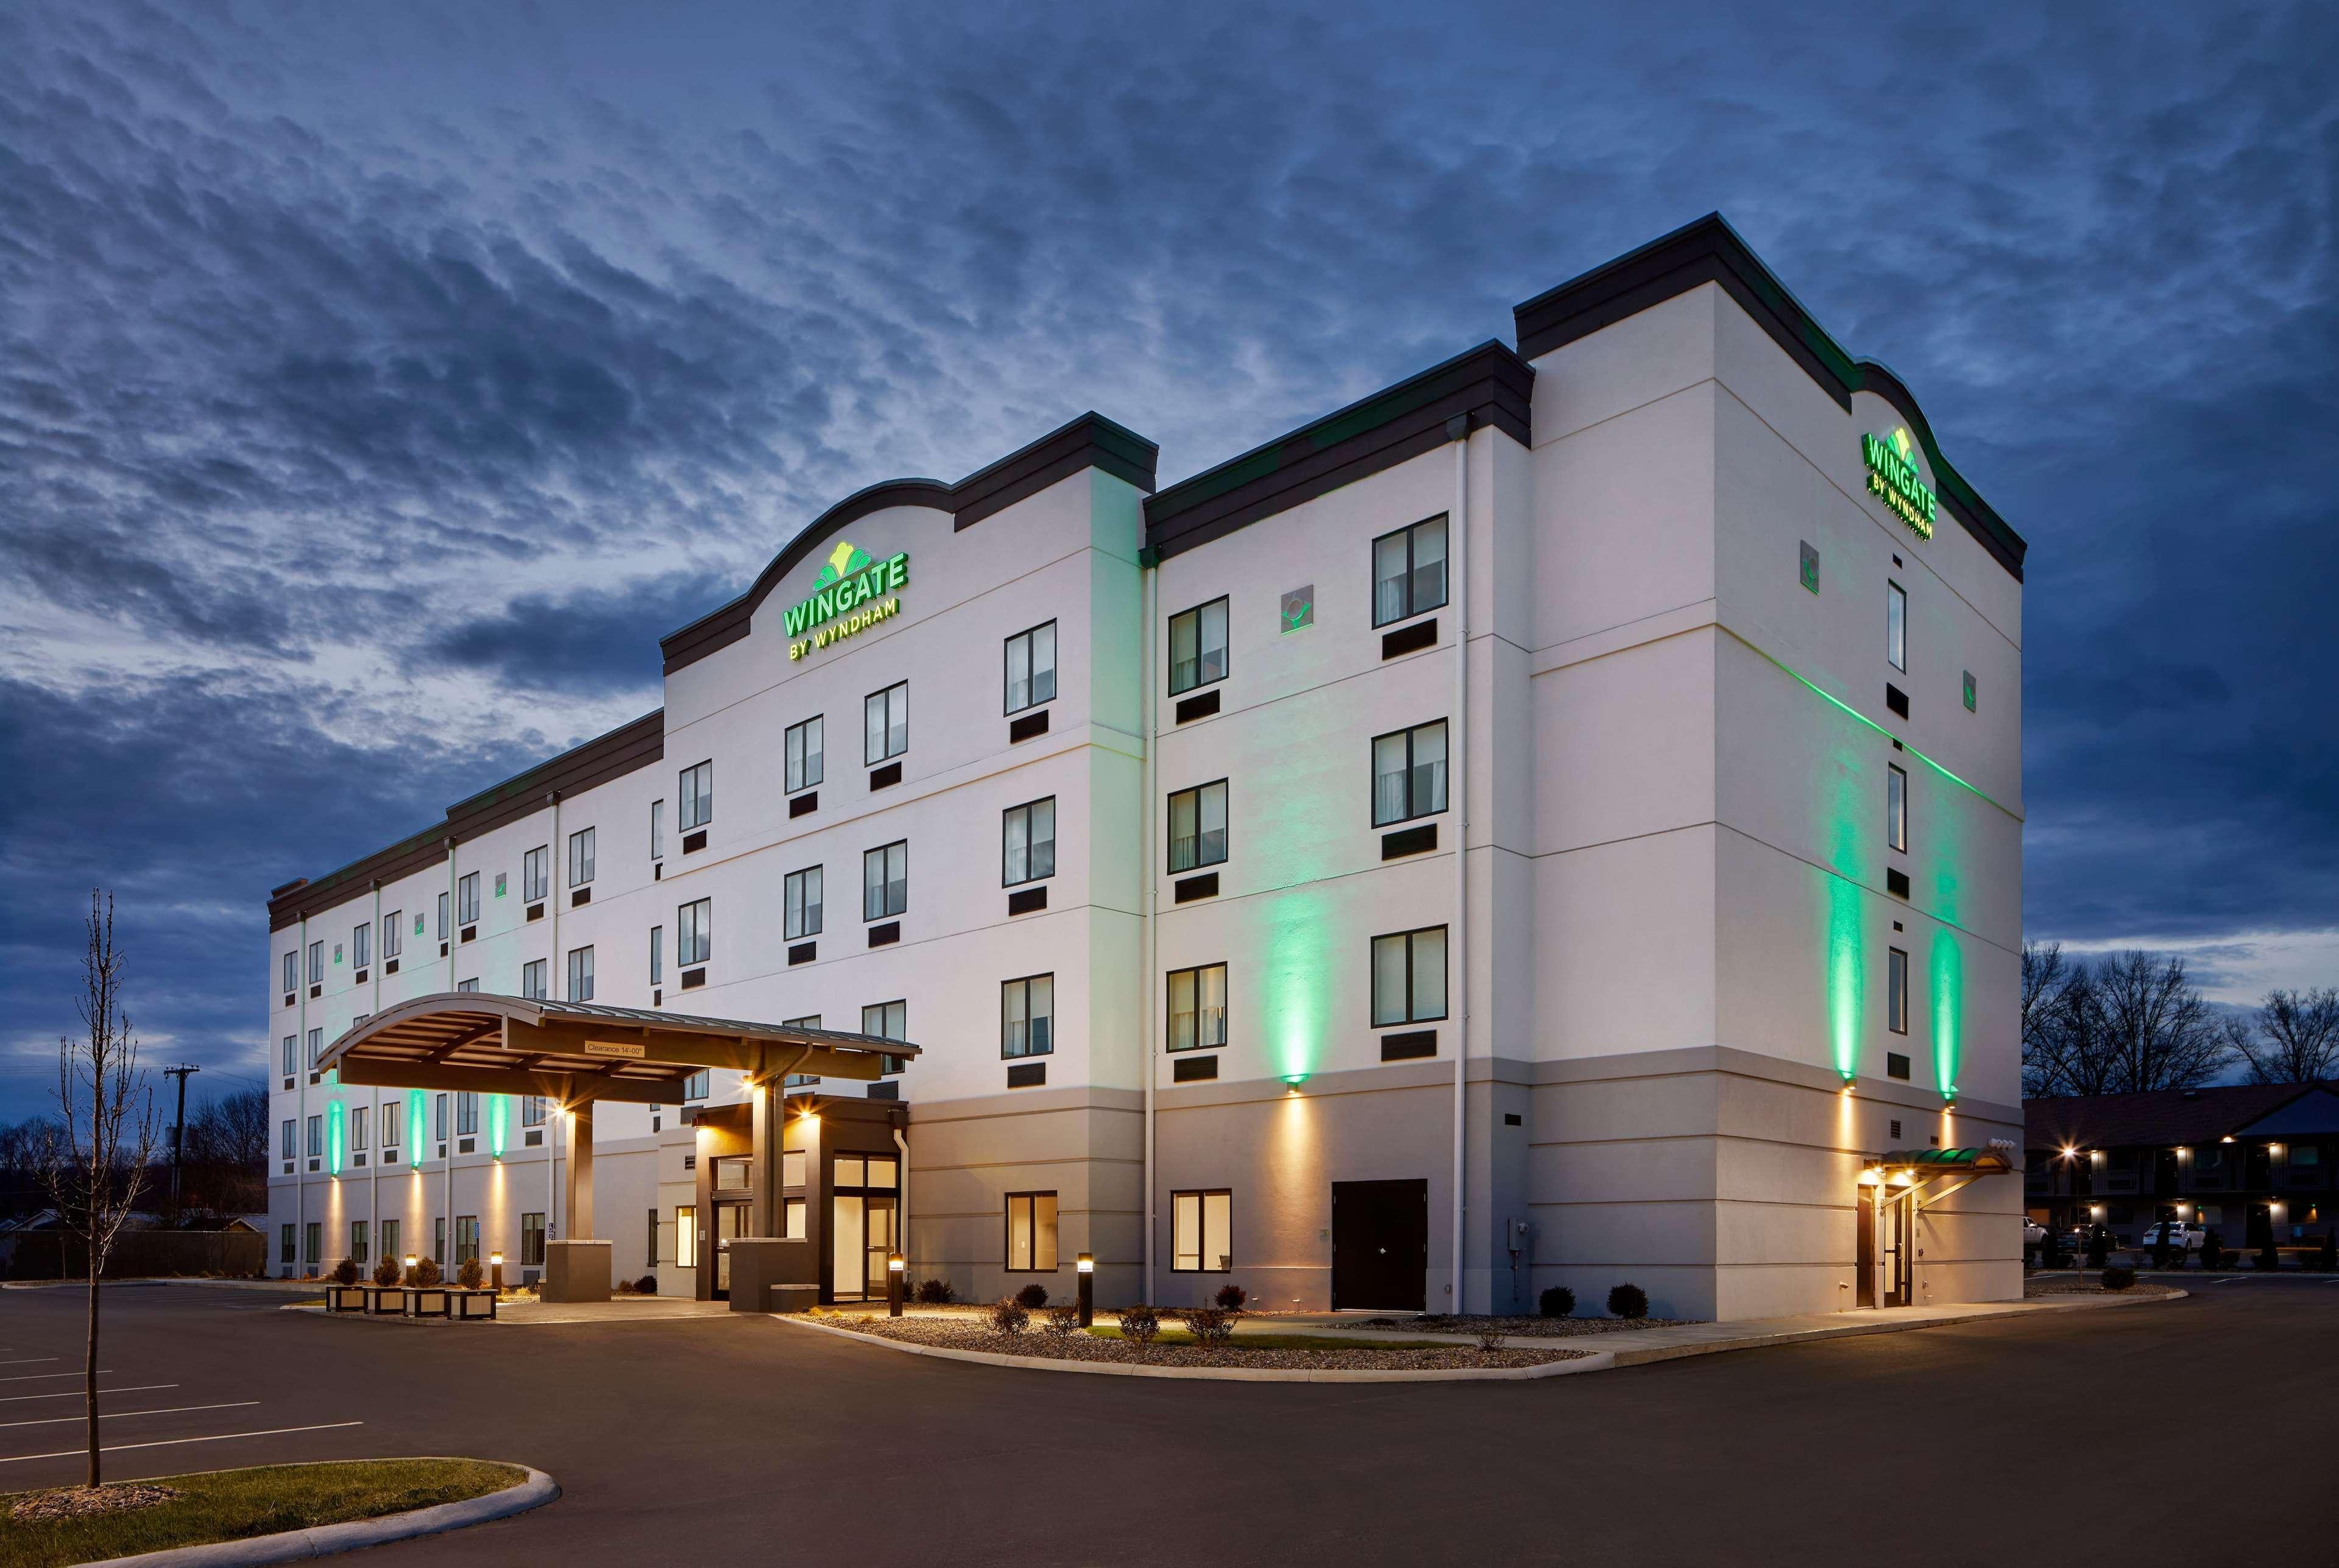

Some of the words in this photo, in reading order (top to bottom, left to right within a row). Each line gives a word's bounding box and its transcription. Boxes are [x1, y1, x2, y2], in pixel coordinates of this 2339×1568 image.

[1864, 433, 1936, 522] WINGATE
[1870, 473, 1884, 495] BY
[1887, 487, 1932, 540] WYNDHAM
[782, 552, 908, 638] WINGATE
[789, 639, 811, 661] BY
[814, 598, 899, 649] WYNDHAM
[588, 1044, 619, 1053] Clearance
